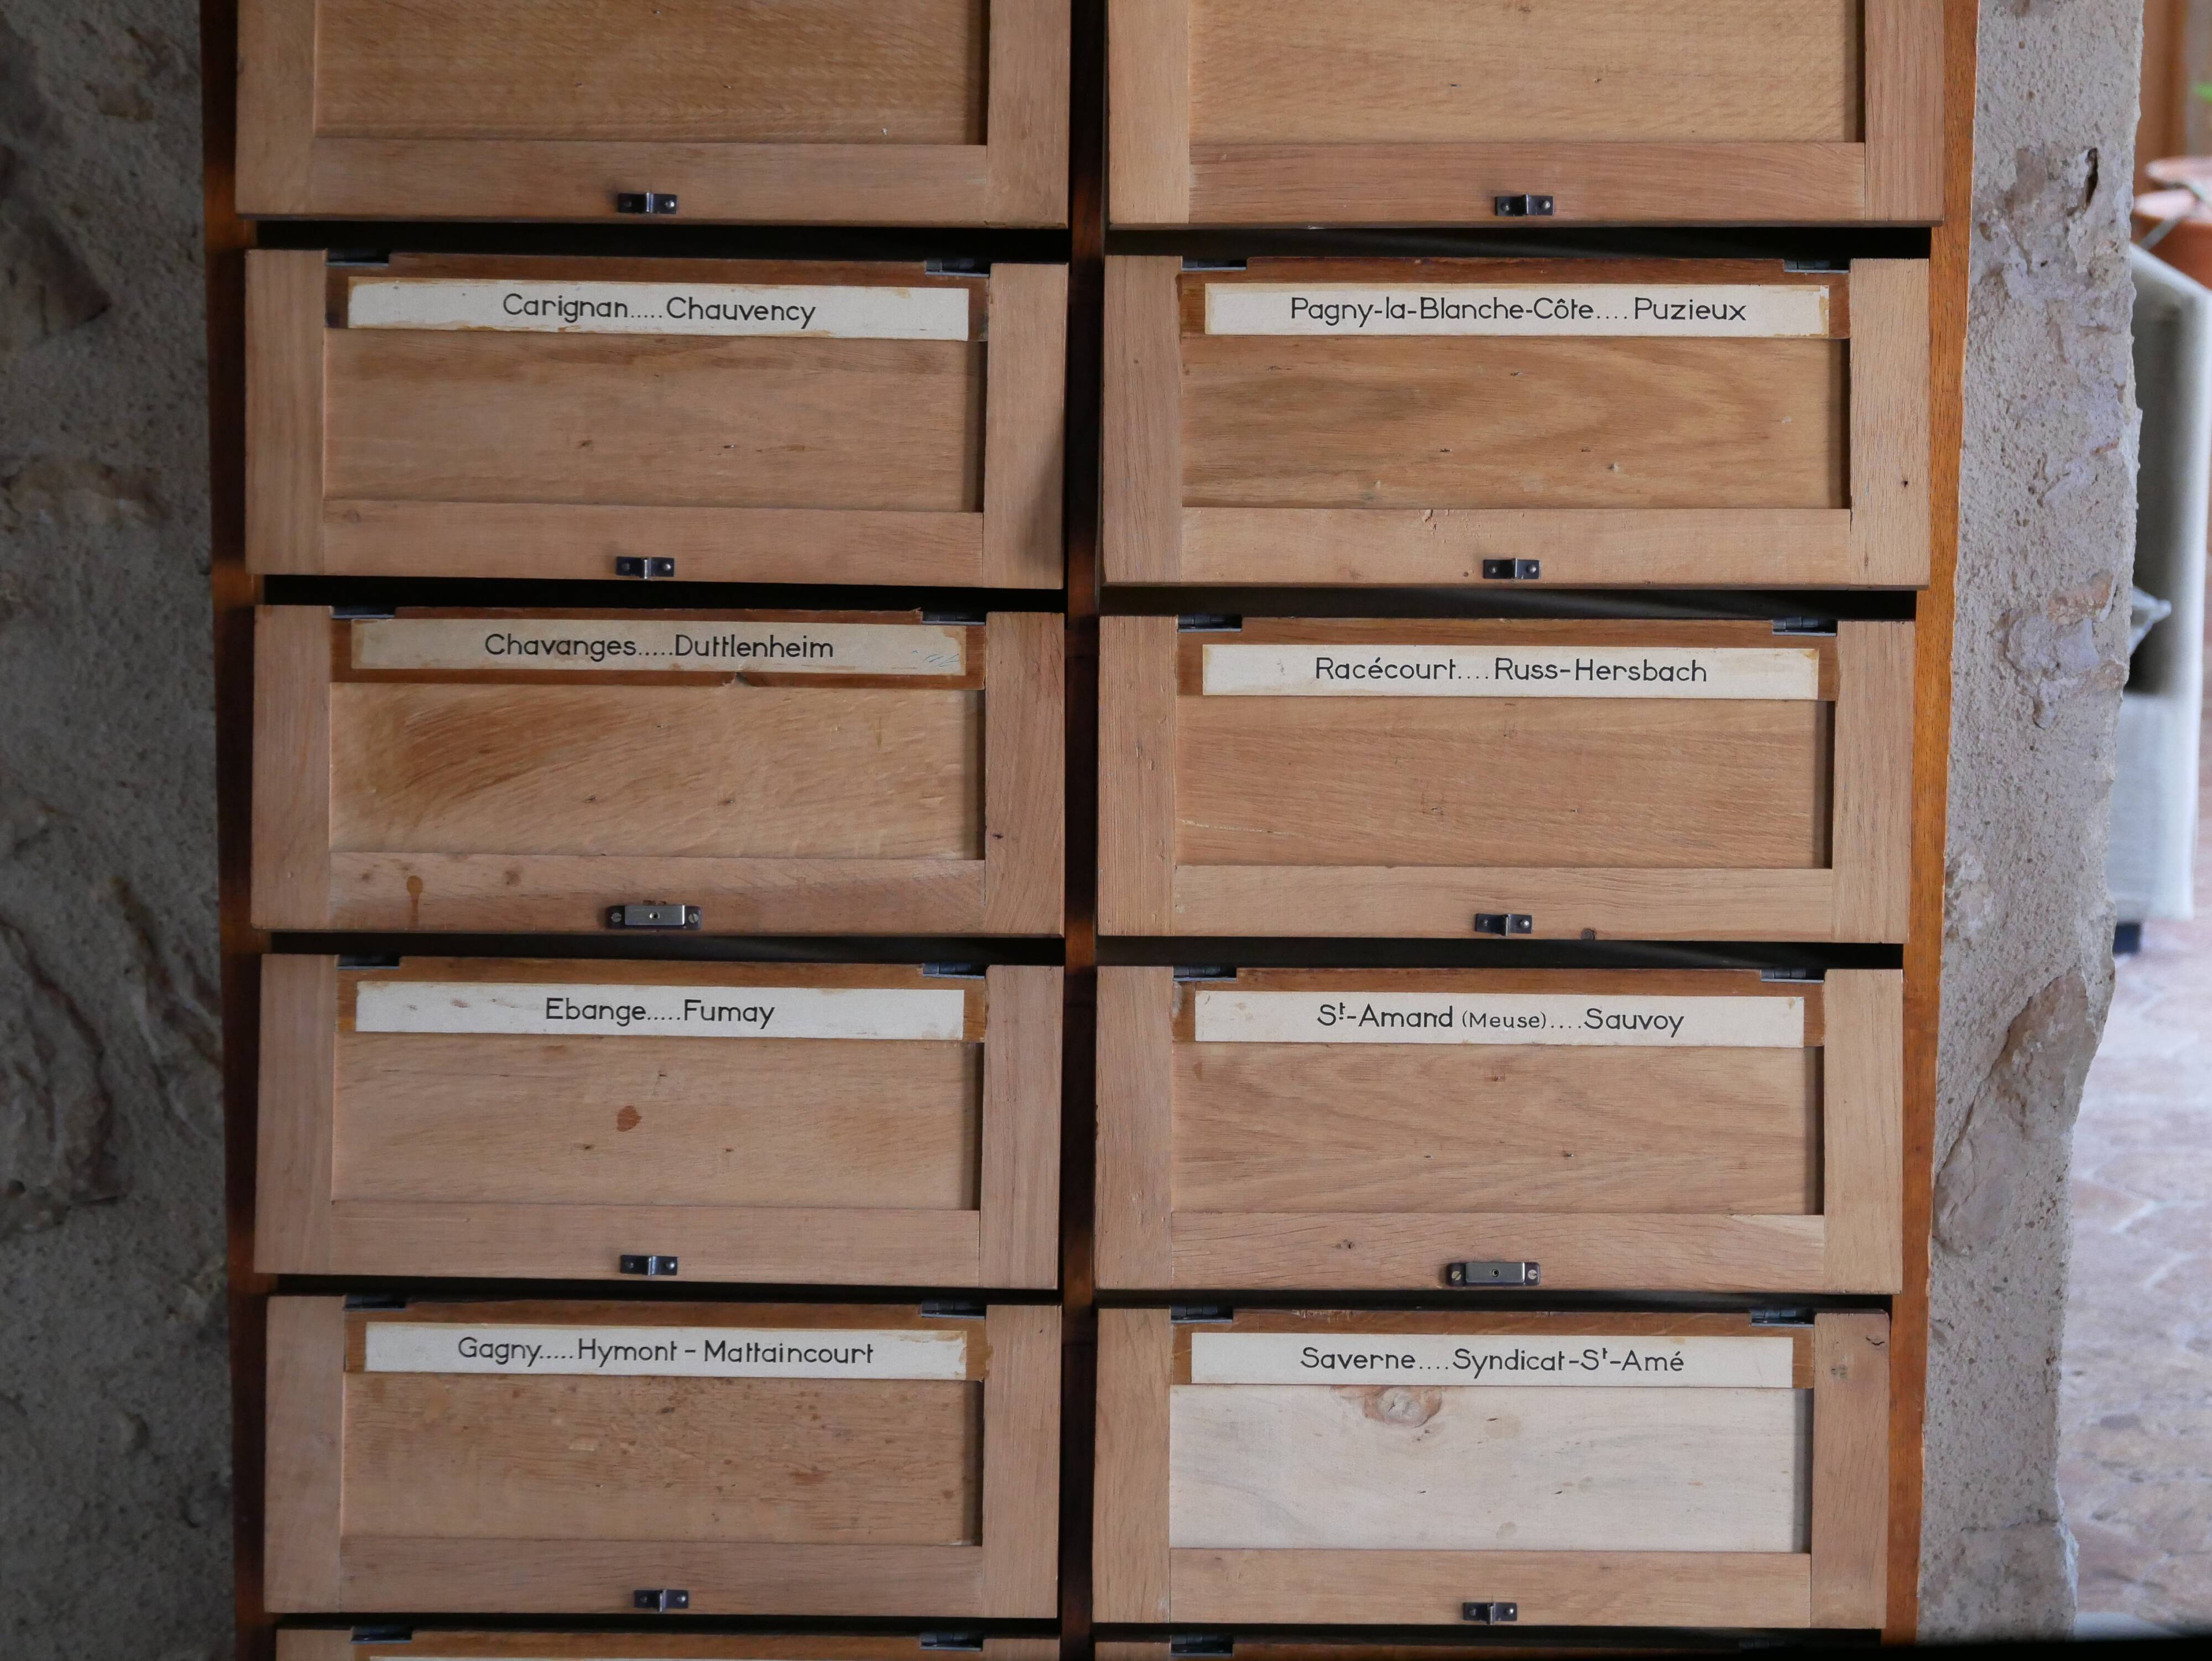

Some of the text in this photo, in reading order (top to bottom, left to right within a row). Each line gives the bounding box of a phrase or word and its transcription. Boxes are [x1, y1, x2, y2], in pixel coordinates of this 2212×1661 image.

[1635, 297, 1747, 321] Puzieux
[1495, 657, 1707, 682] Russ-Hersbach
[704, 1340, 874, 1364] Mattaincourt
